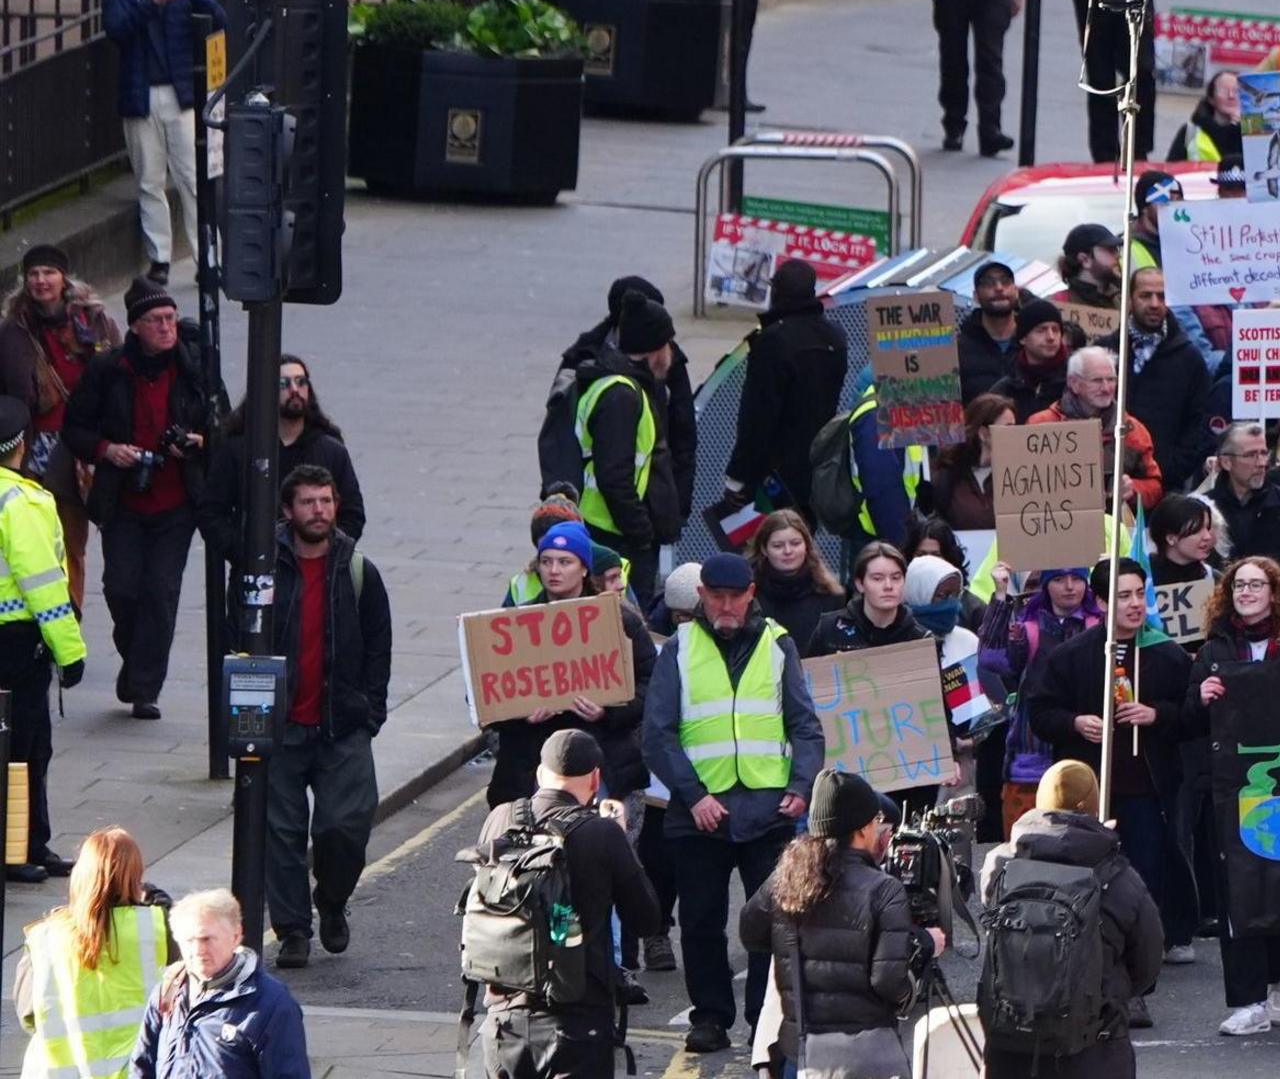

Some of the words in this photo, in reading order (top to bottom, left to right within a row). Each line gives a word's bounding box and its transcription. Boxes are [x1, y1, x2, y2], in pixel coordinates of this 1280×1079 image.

[1186, 223, 1234, 254] Still
[1202, 252, 1223, 265] the
[1189, 271, 1240, 290] different
[876, 306, 903, 326] THE
[907, 303, 942, 326] WAR
[904, 354, 921, 374] IS
[1026, 430, 1078, 455] GAYS
[1001, 462, 1098, 497] AGAINST
[1019, 499, 1074, 537] GAS
[490, 605, 602, 656] STOP
[480, 649, 623, 705] ROSEBANK
[803, 658, 881, 712] UR
[827, 698, 945, 759] UTURE
